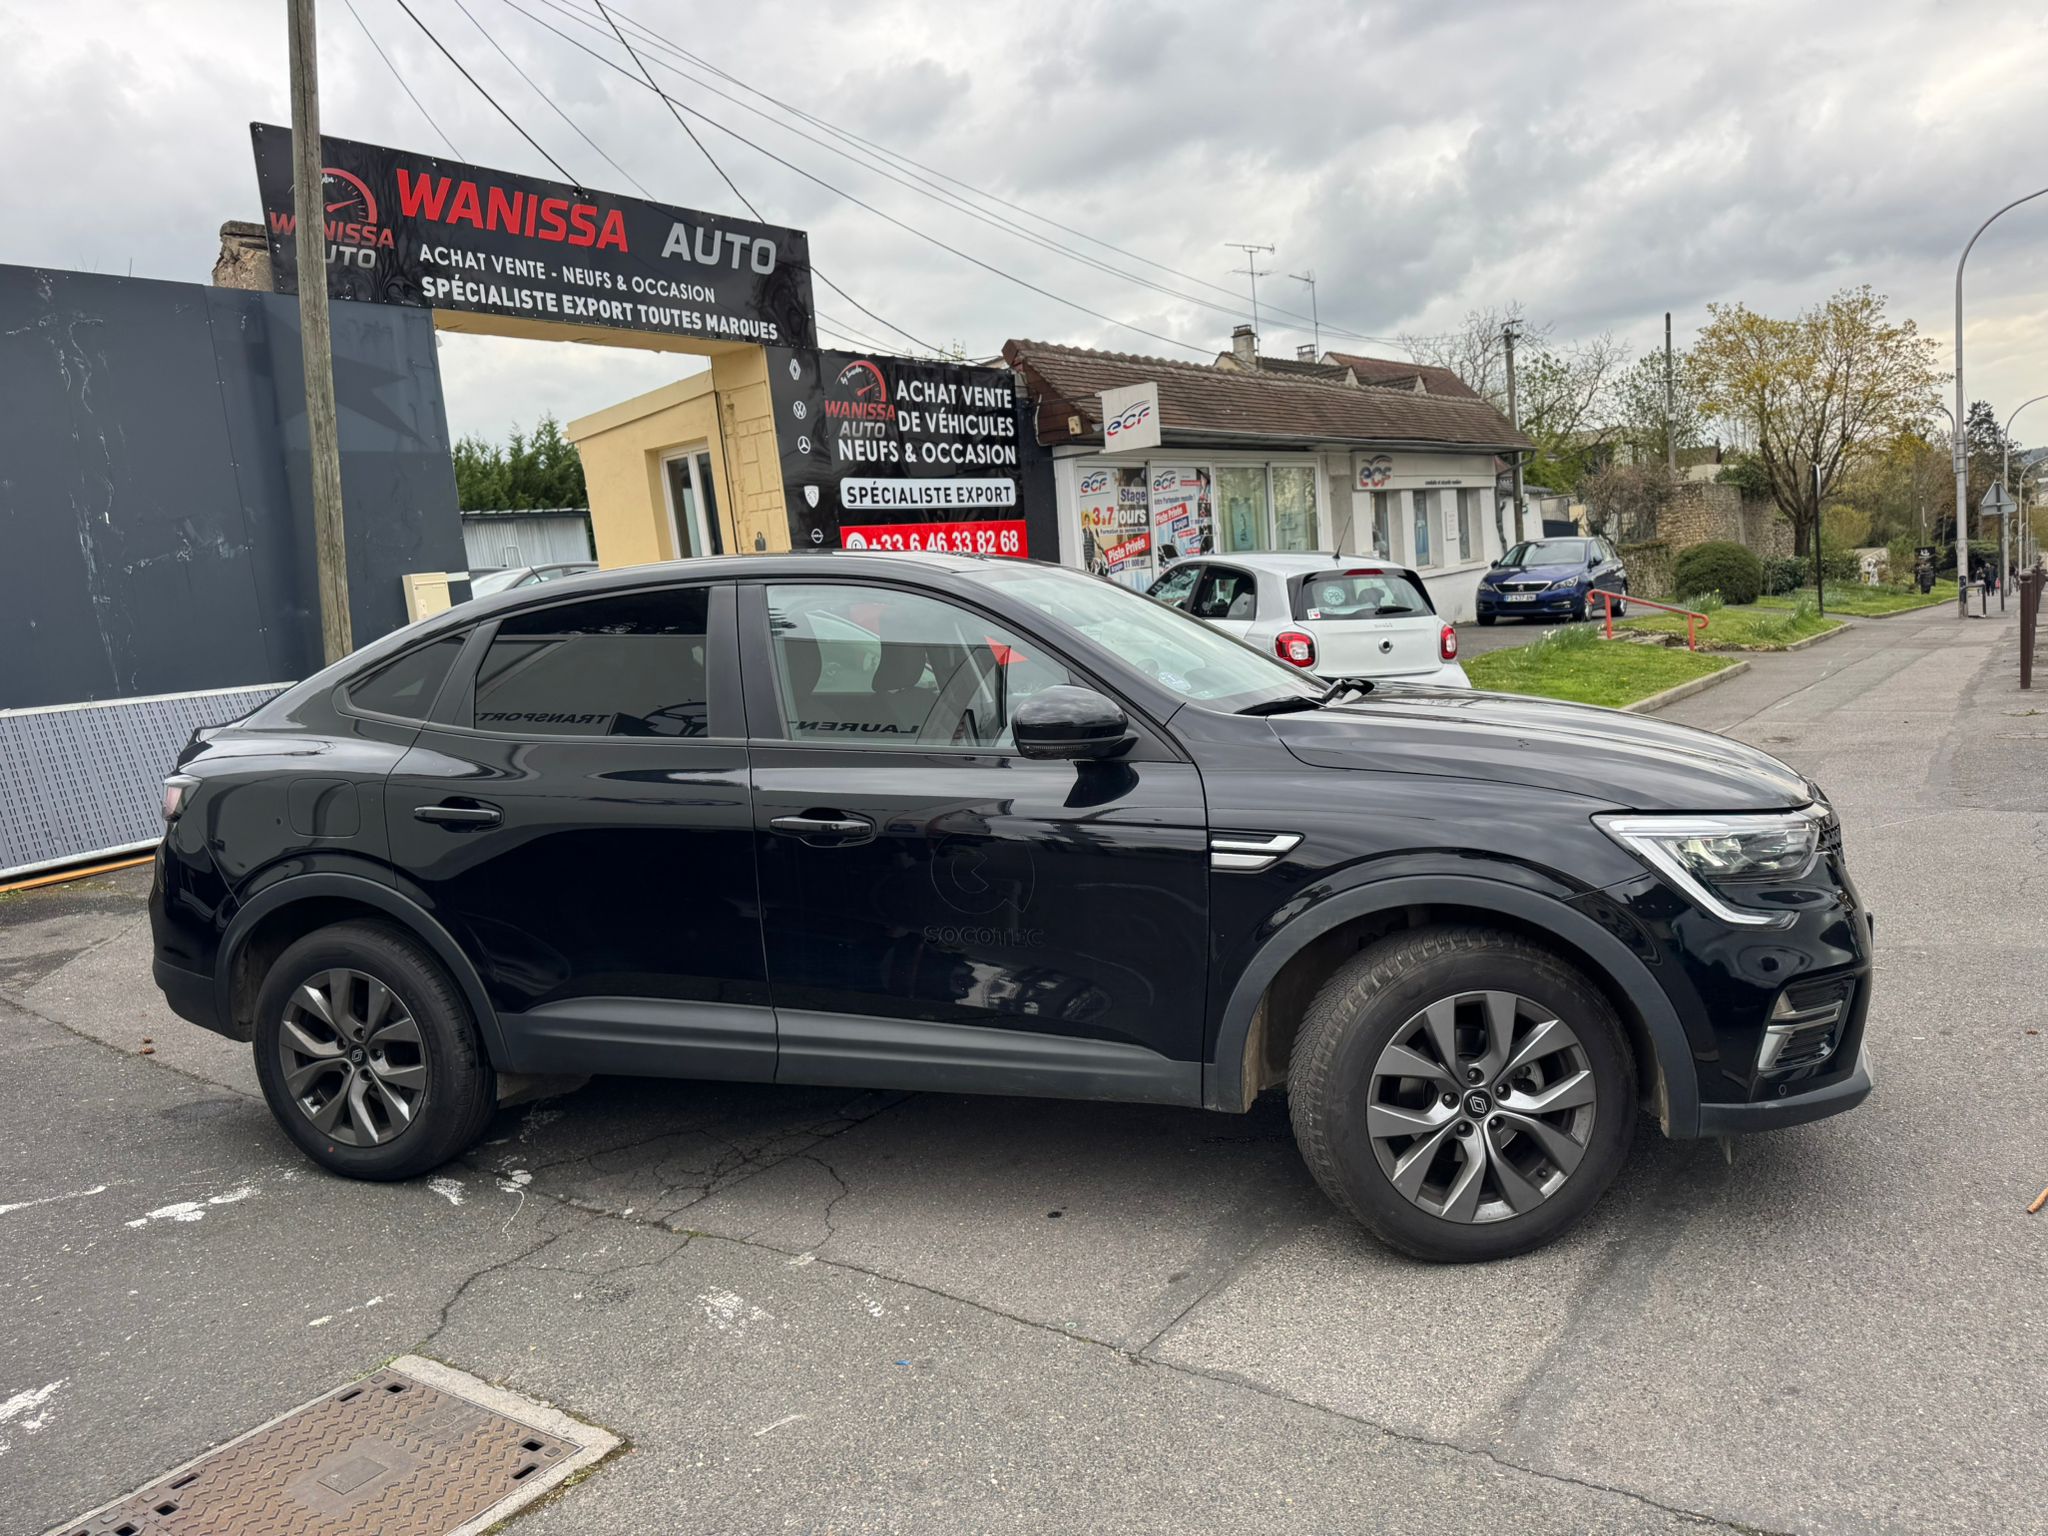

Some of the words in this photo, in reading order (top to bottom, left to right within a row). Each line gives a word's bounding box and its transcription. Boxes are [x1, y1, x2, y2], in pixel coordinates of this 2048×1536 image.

[270, 212, 394, 249] WNISSA
[396, 168, 629, 253] WANISSA
[661, 222, 777, 275] AUTO
[322, 245, 377, 269] UTO
[420, 243, 486, 271] ACHAT
[491, 254, 546, 280] VENTE
[562, 266, 612, 290] NEUFS
[617, 276, 628, 291] &
[631, 276, 716, 304] OCCASION
[421, 274, 559, 313] SPÉCIALISTE
[561, 294, 634, 322] EXPORT
[636, 304, 703, 330] TOUTES
[705, 314, 779, 341] MARQUES
[896, 379, 957, 405] ACHAT
[961, 385, 1013, 409] VENTE
[824, 400, 896, 421] WANISSA
[897, 410, 921, 432] DE
[925, 407, 1015, 437] VÉHICULES
[839, 420, 886, 438] AUTO
[838, 438, 899, 463] NEUFS
[905, 443, 918, 463] &
[922, 442, 1017, 465] OCCASION
[847, 480, 953, 504] SPÉCIALISTE
[957, 486, 1012, 504] EXPORT
[1120, 488, 1147, 504] Stage
[1092, 506, 1101, 526] 3
[1106, 506, 1114, 525] 7
[869, 533, 901, 550] +33
[909, 533, 921, 550] 6
[927, 532, 949, 551] 46
[951, 531, 973, 552] 33
[977, 530, 996, 553] 82
[1000, 530, 1019, 553] 68
[1108, 548, 1125, 563] Piste
[1125, 537, 1146, 555] Privée
[922, 925, 1046, 948] SOCOTEC
